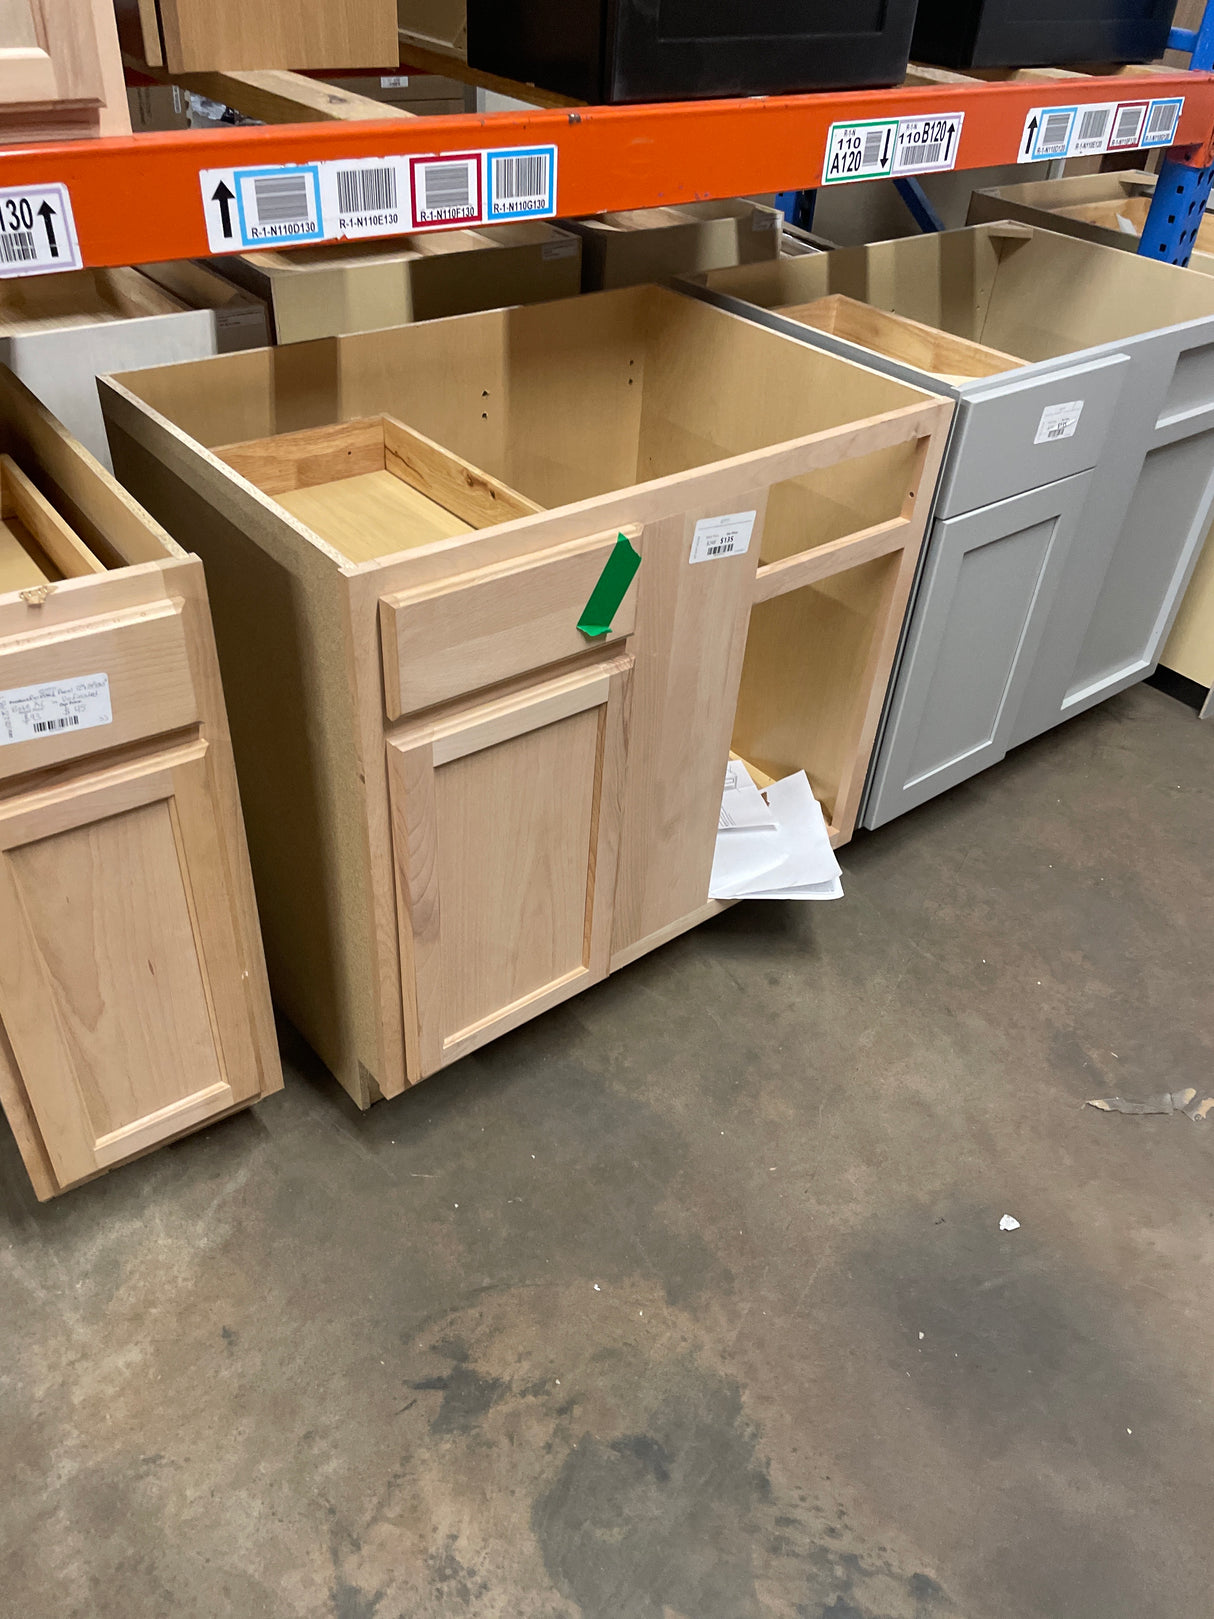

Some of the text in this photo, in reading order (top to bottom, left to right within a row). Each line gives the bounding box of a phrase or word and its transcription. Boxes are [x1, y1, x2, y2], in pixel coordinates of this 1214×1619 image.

[899, 120, 947, 145] 110 B120
[837, 136, 862, 151] 110
[830, 150, 862, 175] A120
[420, 206, 475, 221] R-1-N110F130
[493, 199, 546, 213] R-1-N110G130
[339, 213, 399, 229] R-1-N110E130
[251, 221, 316, 238] R-1-N110D130
